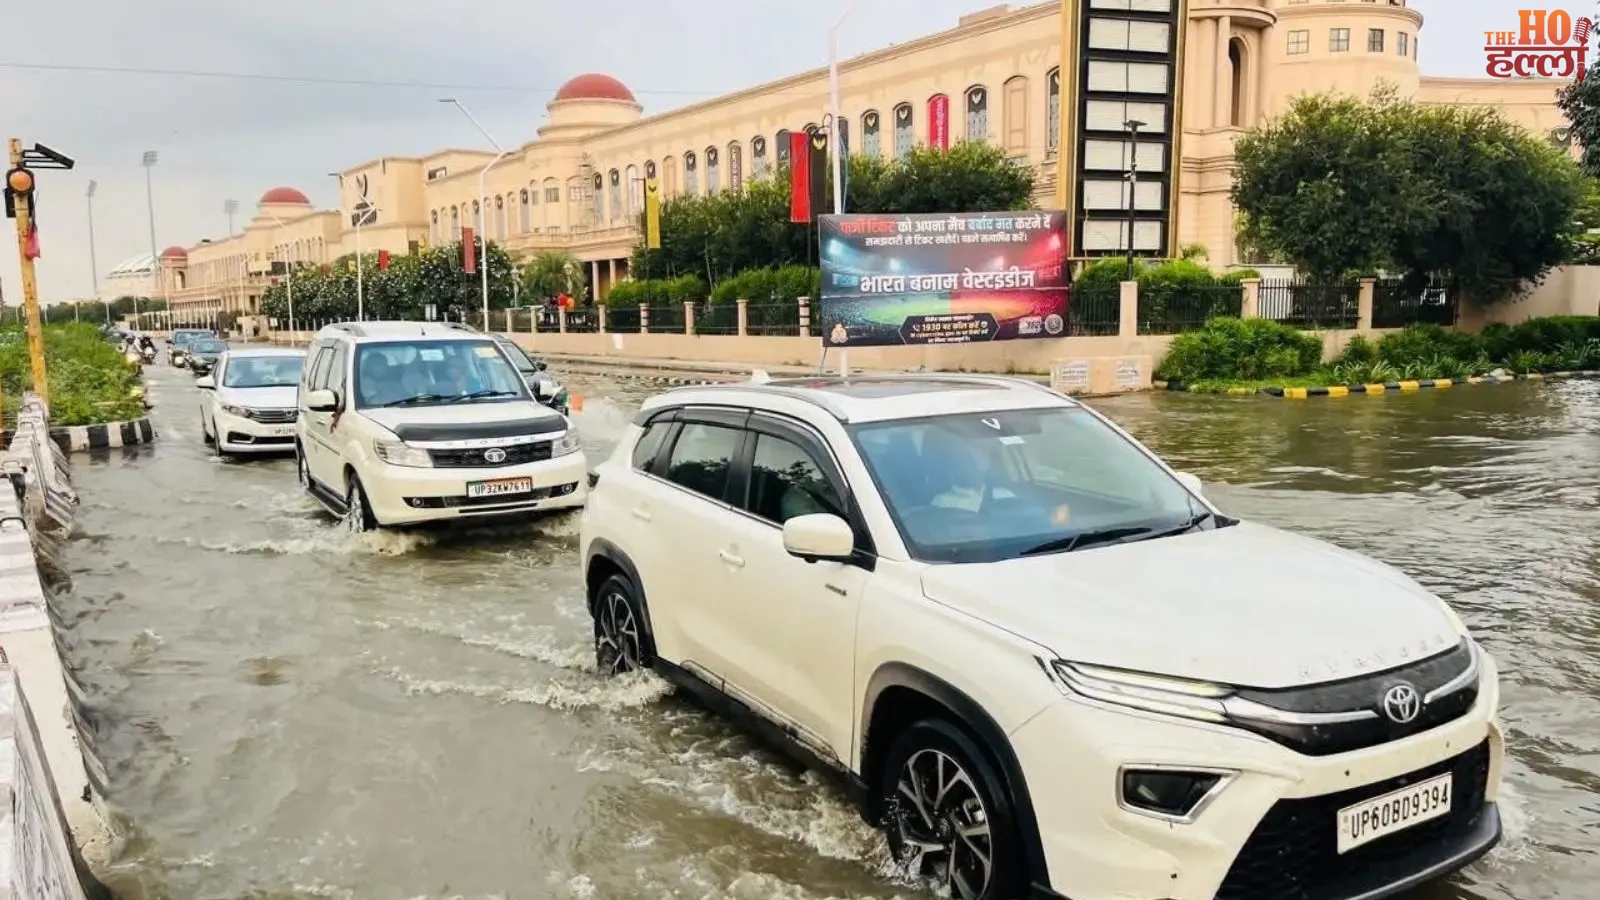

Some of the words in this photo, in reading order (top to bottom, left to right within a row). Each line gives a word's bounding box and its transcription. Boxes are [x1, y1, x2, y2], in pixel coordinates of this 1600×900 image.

[896, 216, 912, 233] को
[914, 219, 946, 233] अपना
[947, 216, 965, 231] मैच
[1015, 214, 1041, 229] करने
[860, 275, 905, 293] भारत
[909, 273, 958, 291] बनाम
[961, 266, 1035, 290] वेस्टइंडीज
[1351, 782, 1448, 839] UP60BD9394
